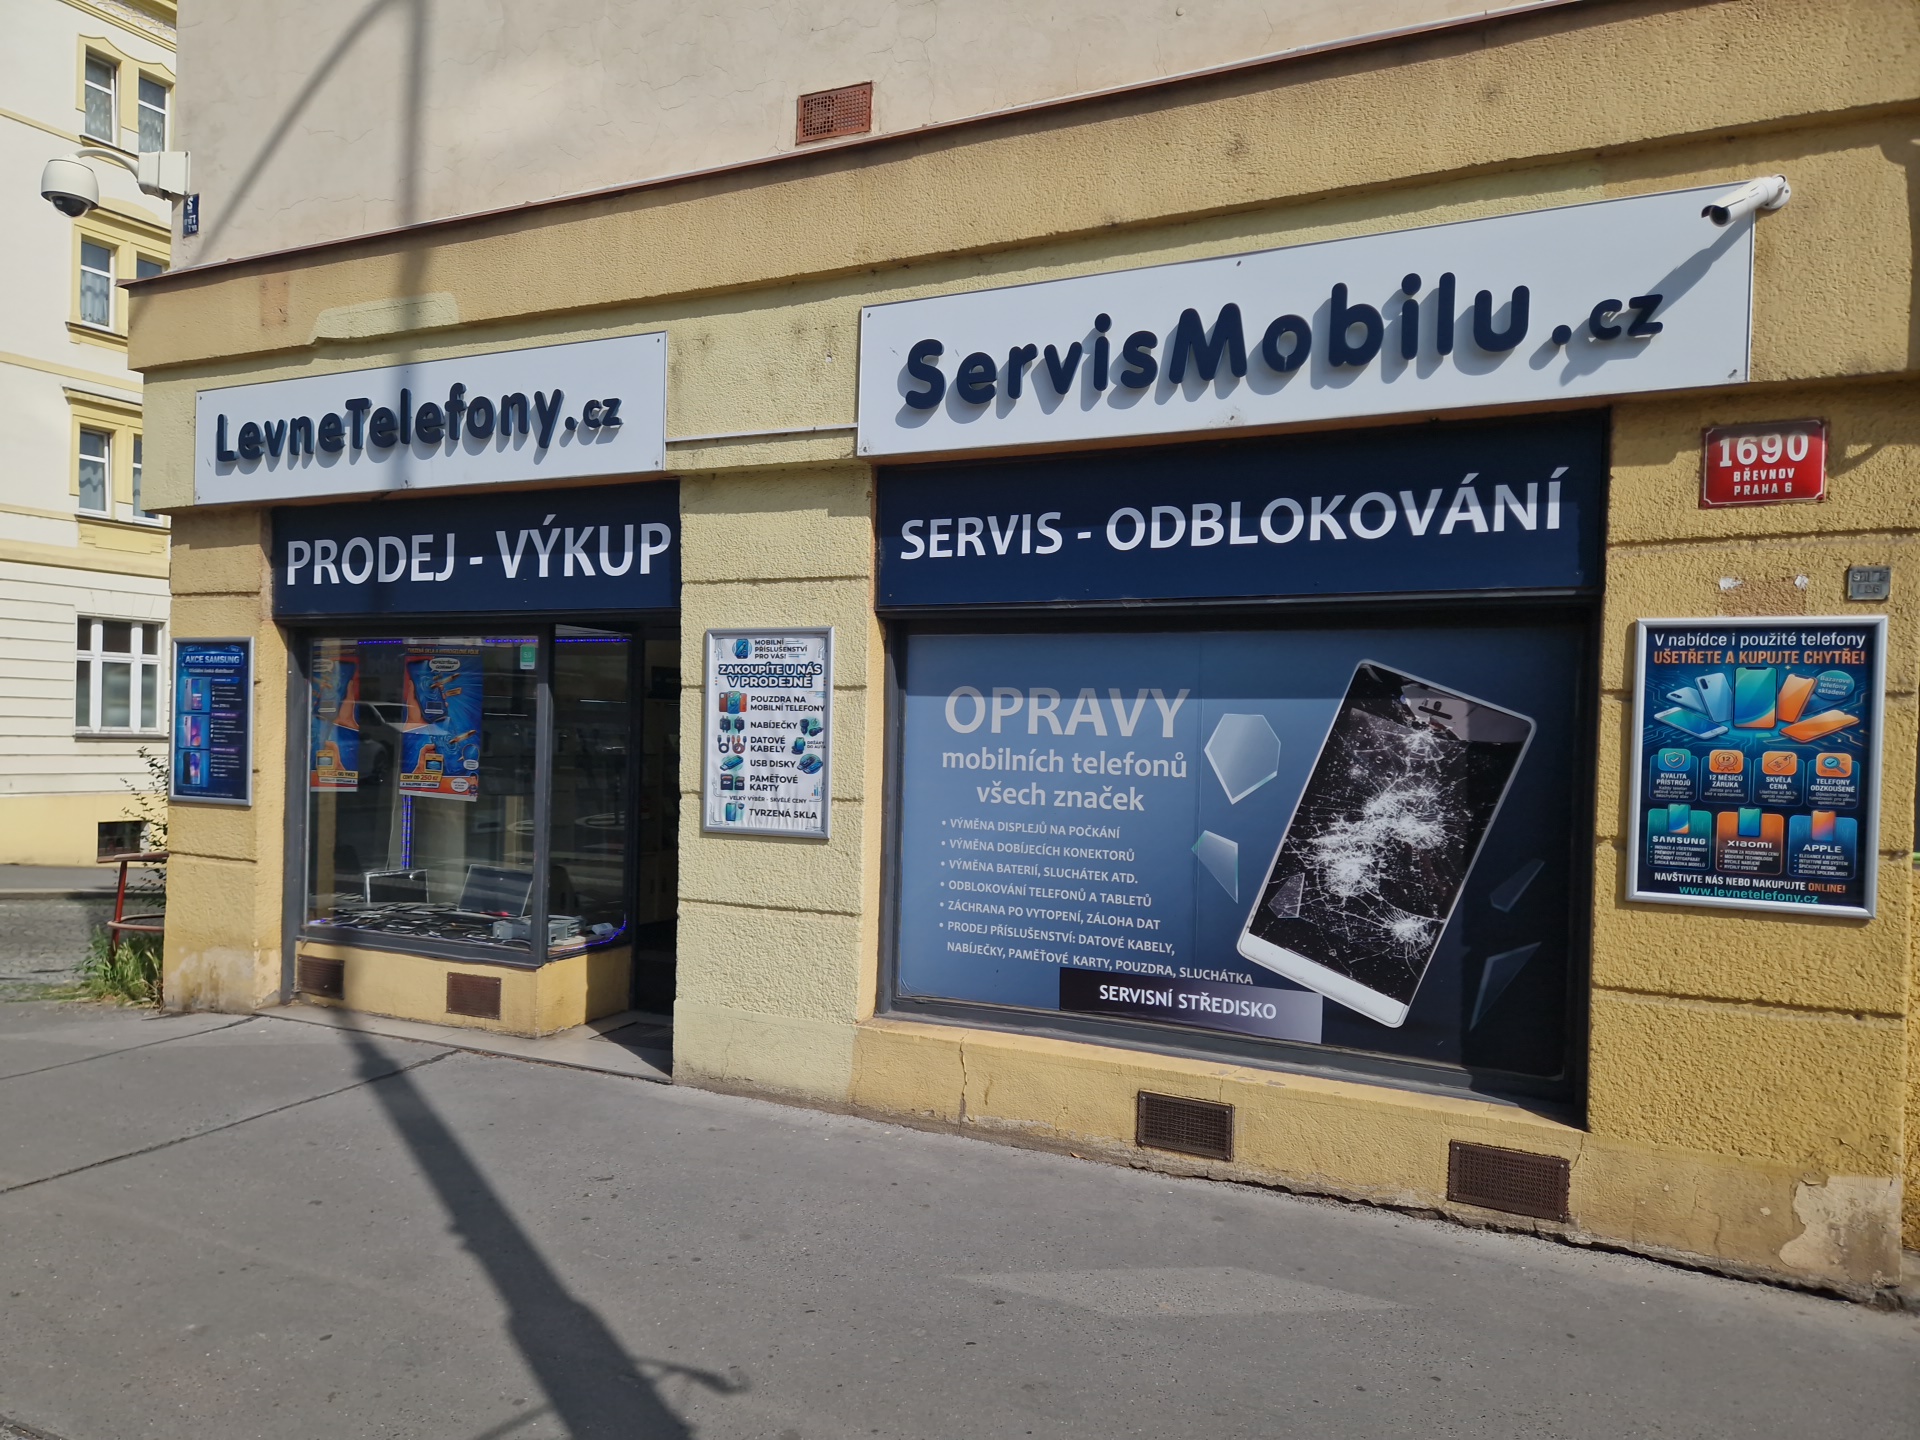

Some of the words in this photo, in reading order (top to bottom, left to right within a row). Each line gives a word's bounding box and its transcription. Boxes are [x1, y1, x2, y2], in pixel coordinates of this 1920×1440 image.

[905, 272, 1663, 409] ServisMobilu.cz
[216, 382, 623, 462] LevneTelefony.cz
[1719, 431, 1809, 468] 1690
[1733, 468, 1795, 482] BŘEVNOV
[1733, 483, 1778, 496] PRAHA
[1784, 482, 1792, 493] 6
[900, 511, 1062, 560] SERVIS
[1105, 466, 1570, 551] ODBLOKOVÁNÍ
[286, 532, 456, 586] PRODEJ
[496, 513, 672, 579] VÝKUP
[754, 638, 784, 646] MOBILNÍ
[1654, 634, 1666, 646] V
[1668, 632, 1727, 647] nabídce
[1731, 633, 1736, 646] i
[1740, 632, 1797, 648] použité
[1801, 632, 1866, 649] telefony
[754, 645, 808, 653] PŘÍSLUŠENSTVÍ
[185, 655, 204, 664] AKCE
[204, 656, 240, 664] SAMSUNG
[1654, 649, 1722, 664] UŠETŘETE
[1725, 651, 1735, 664] A
[1738, 651, 1799, 664] KUPUJTE
[1803, 649, 1865, 664] CHYTŘE!
[718, 662, 784, 675] ZAKOUPÍTE
[785, 664, 796, 675] U
[797, 662, 822, 675] NÁS
[728, 676, 738, 688] V
[740, 674, 813, 688] PRODEJNĚ
[1818, 688, 1846, 696] skladem
[750, 703, 784, 712] MOBILNÍ
[944, 685, 1191, 738] OPRAVY
[750, 720, 798, 730] NABÍJEČKY
[750, 736, 786, 744] DATOVÉ
[750, 744, 786, 753] KABELY
[750, 759, 768, 768] USB
[770, 760, 796, 768] DISKY
[942, 747, 1064, 773] mobilních
[1072, 751, 1187, 778] telefonů
[750, 774, 798, 784] PAMĚŤOVÉ
[1660, 772, 1686, 780] KVALITA
[1718, 774, 1743, 782] MĚSÍCŮ
[1766, 776, 1792, 784] SKVĚLÁ
[1816, 778, 1850, 786] TELEFONY
[750, 784, 780, 792] KARTY
[976, 780, 1046, 806] všech
[1053, 785, 1145, 812] značek
[749, 808, 791, 818] TVRZENÁ
[794, 810, 818, 820] SKLA
[950, 817, 996, 831] VÝMĚNA
[998, 821, 1047, 834] DISPLEJŮ
[1050, 825, 1066, 836] NA
[1068, 824, 1121, 839] POČKÁNÍ
[1652, 836, 1706, 844] SAMSUNG
[949, 838, 994, 852] VÝMĚNA
[997, 842, 1060, 856] DOBÍJECÍCH
[1063, 848, 1135, 862] KONEKTORŮ
[1803, 844, 1842, 853] APPLE
[949, 858, 994, 872] VÝMĚNA
[996, 864, 1042, 878] BATERIÍ,
[1043, 866, 1109, 882] SLUCHÁTEK
[1111, 872, 1138, 884] ATD.
[1654, 872, 1702, 884] NAVŠTIVTE
[1705, 875, 1724, 884] NÁS
[1726, 878, 1750, 887] NEBO
[1752, 878, 1806, 890] NAKUPUJTE
[1808, 883, 1846, 893] ONLINE!
[948, 880, 1026, 896] ODBLOKOVÁNÍ
[1029, 886, 1086, 902] TELEFONŮ
[1088, 892, 1098, 902] A
[1100, 892, 1152, 907] TABLETŮ
[1679, 885, 1818, 904] www.levnetelefony.cz
[948, 900, 1006, 916] ZÁCHRANA
[1008, 906, 1024, 916] PO
[1026, 908, 1084, 925] VYTOPENÍ,
[1086, 912, 1134, 928] ZÁLOHA
[1136, 918, 1161, 930] DAT
[948, 921, 988, 934] PRODEJ
[990, 924, 1076, 944] PŘÍSLUŠENSTVÍ:
[1078, 934, 1124, 949] DATOVÉ
[1128, 940, 1175, 956] KABELY,
[947, 942, 1006, 960] NABÍJEČKY,
[1008, 948, 1069, 964] PAMĚŤOVÉ
[1072, 956, 1113, 970] KARTY,
[1116, 960, 1176, 978] POUZDRA,
[1179, 967, 1254, 984] SLUCHÁTKA
[1099, 984, 1173, 1008] SERVISNÍ
[1178, 991, 1277, 1020] STŘEDISKO
